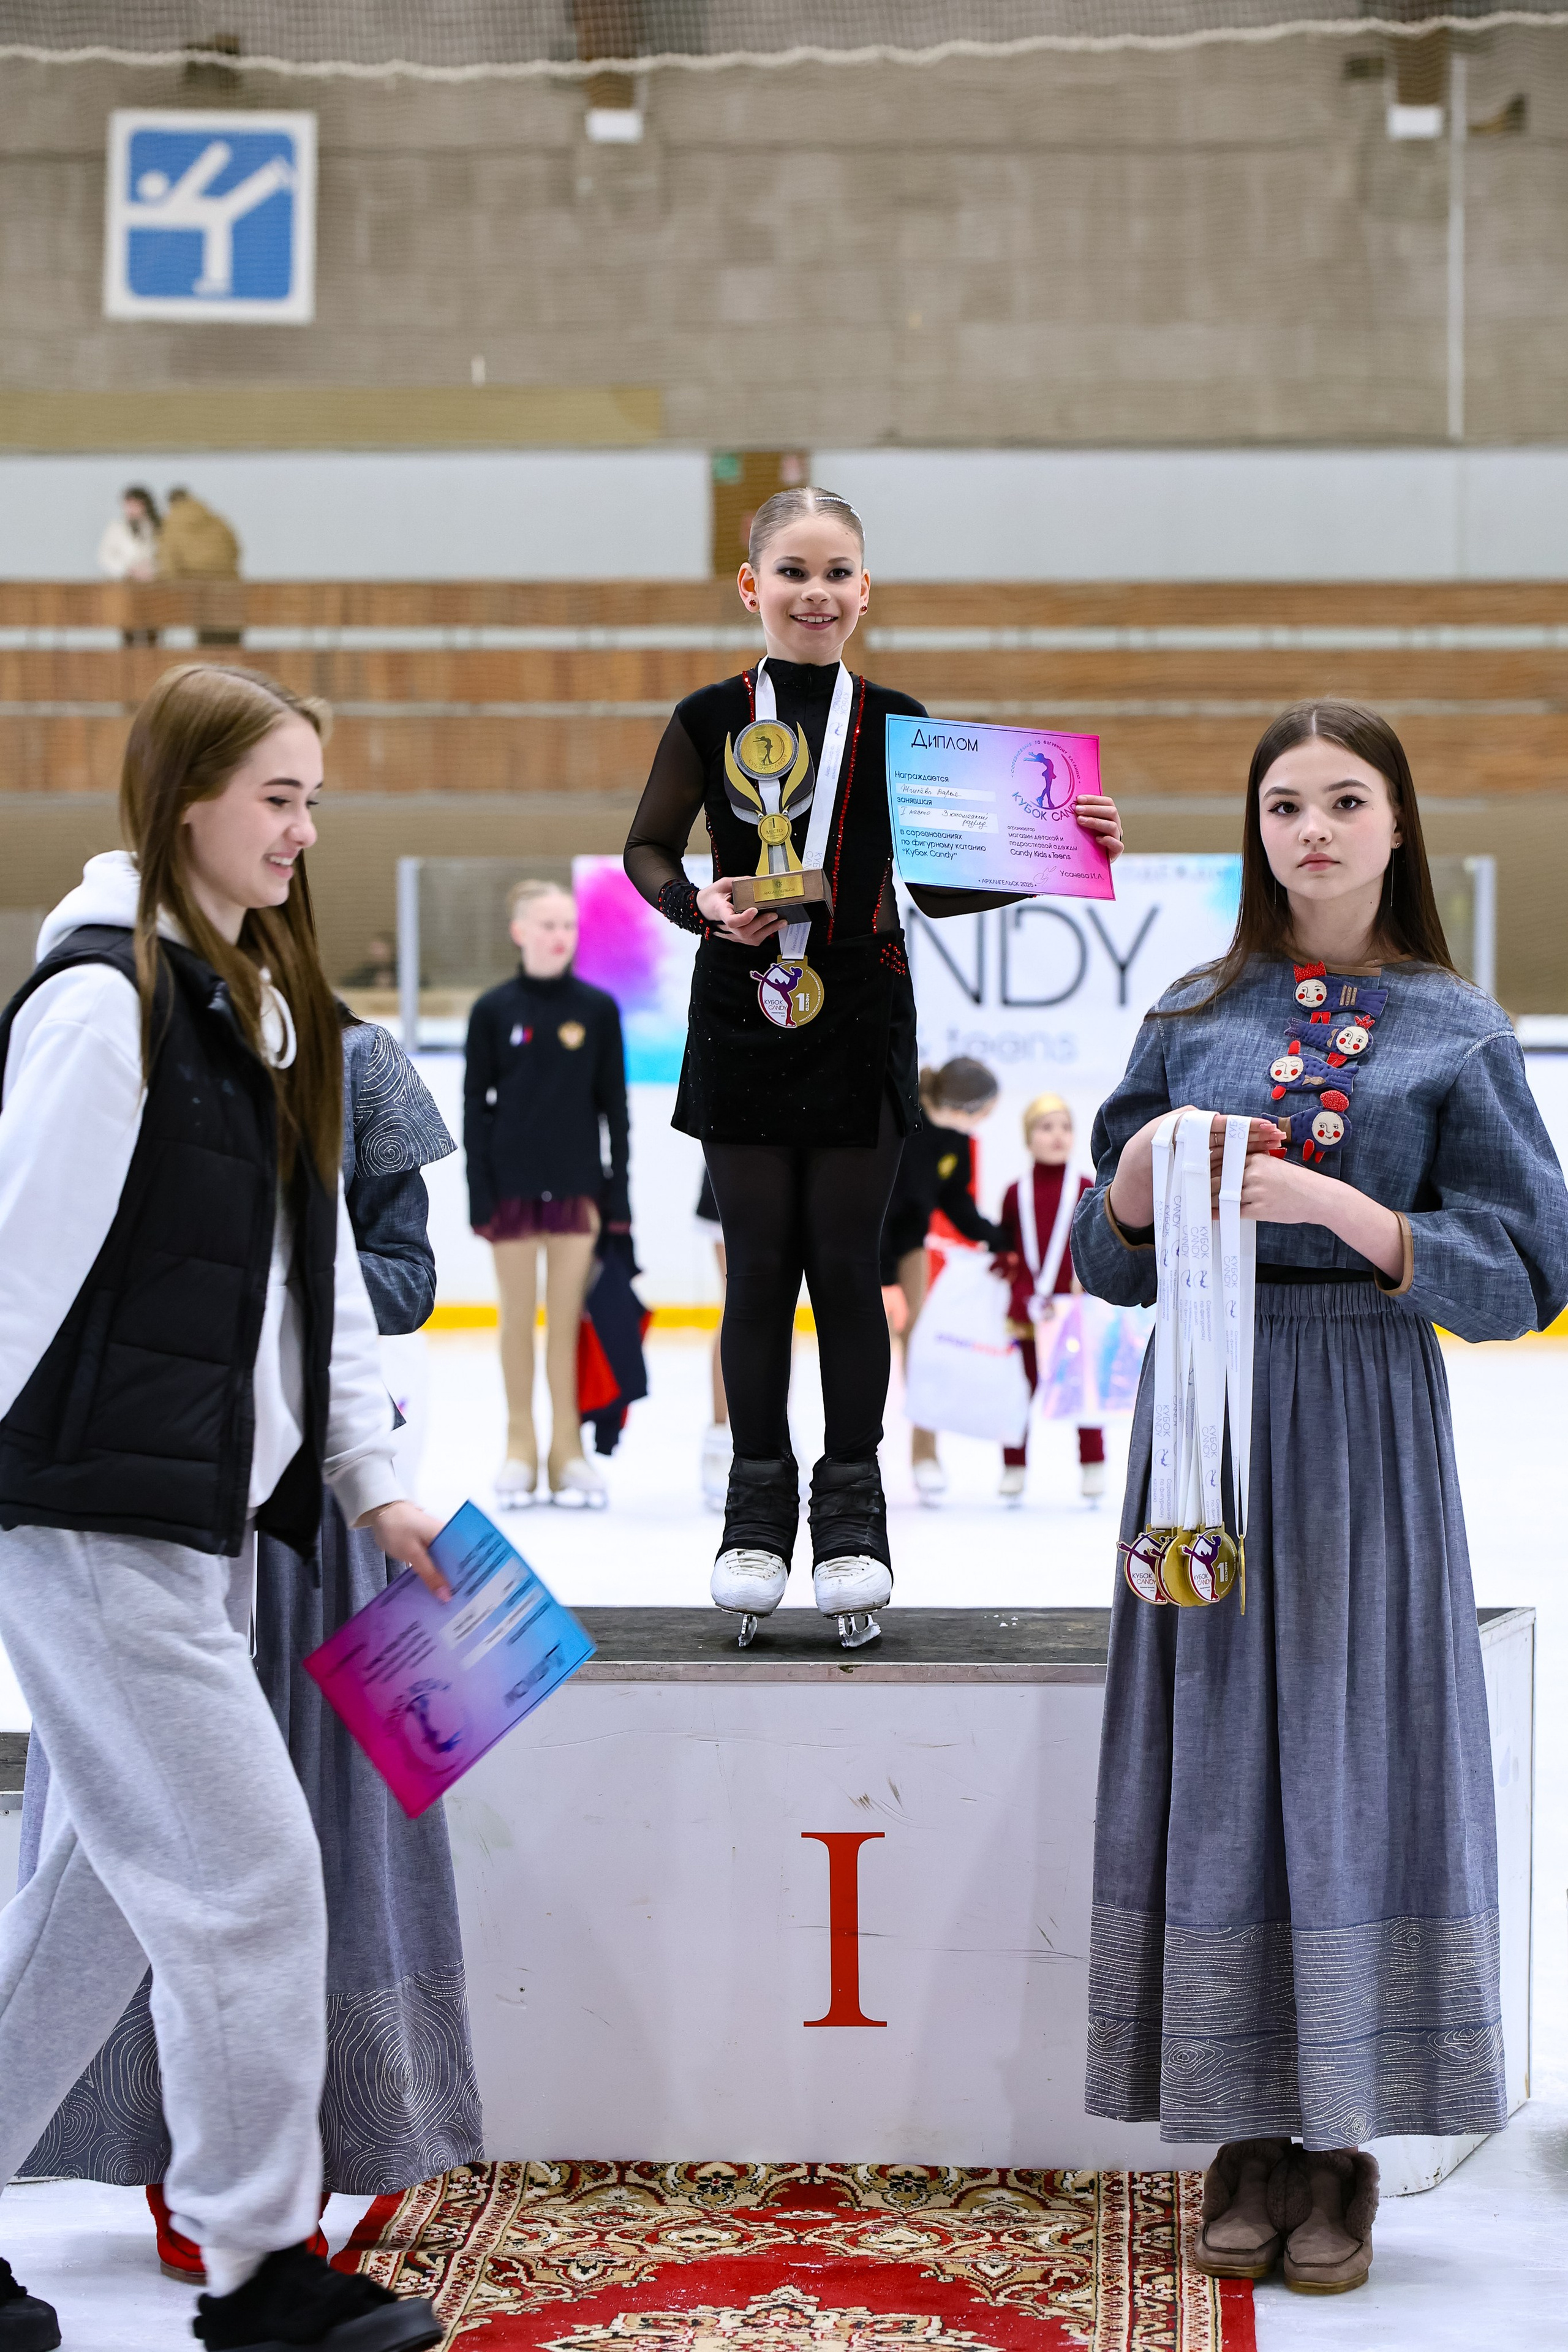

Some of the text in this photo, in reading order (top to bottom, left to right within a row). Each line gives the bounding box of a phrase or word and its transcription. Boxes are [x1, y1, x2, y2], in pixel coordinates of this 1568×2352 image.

[840, 692, 850, 715] КУБОК
[894, 771, 949, 783] Награждается
[897, 797, 932, 805] занявшая
[1012, 791, 1047, 821] КУБОК
[906, 830, 963, 840] соревнованиях
[911, 839, 954, 850] фигурному
[1009, 840, 1052, 850] подростковой
[1010, 848, 1033, 858] Candy
[804, 851, 814, 869] CAN
[812, 851, 823, 868] КУБ
[982, 878, 1019, 887] АРХАНГЕЛЬСК
[1060, 870, 1089, 879] Усачева
[907, 904, 1159, 1008] NDY
[795, 993, 805, 1011] 1
[1228, 1120, 1238, 1139] КУБ
[1172, 1195, 1182, 1229] CANDY
[1191, 1227, 1200, 1259] CANDY
[1200, 1226, 1209, 1259] КУБОК
[1163, 1404, 1171, 1437] КУБОК
[1202, 1426, 1210, 1459] CANDY
[1217, 1562, 1225, 1583] 1
